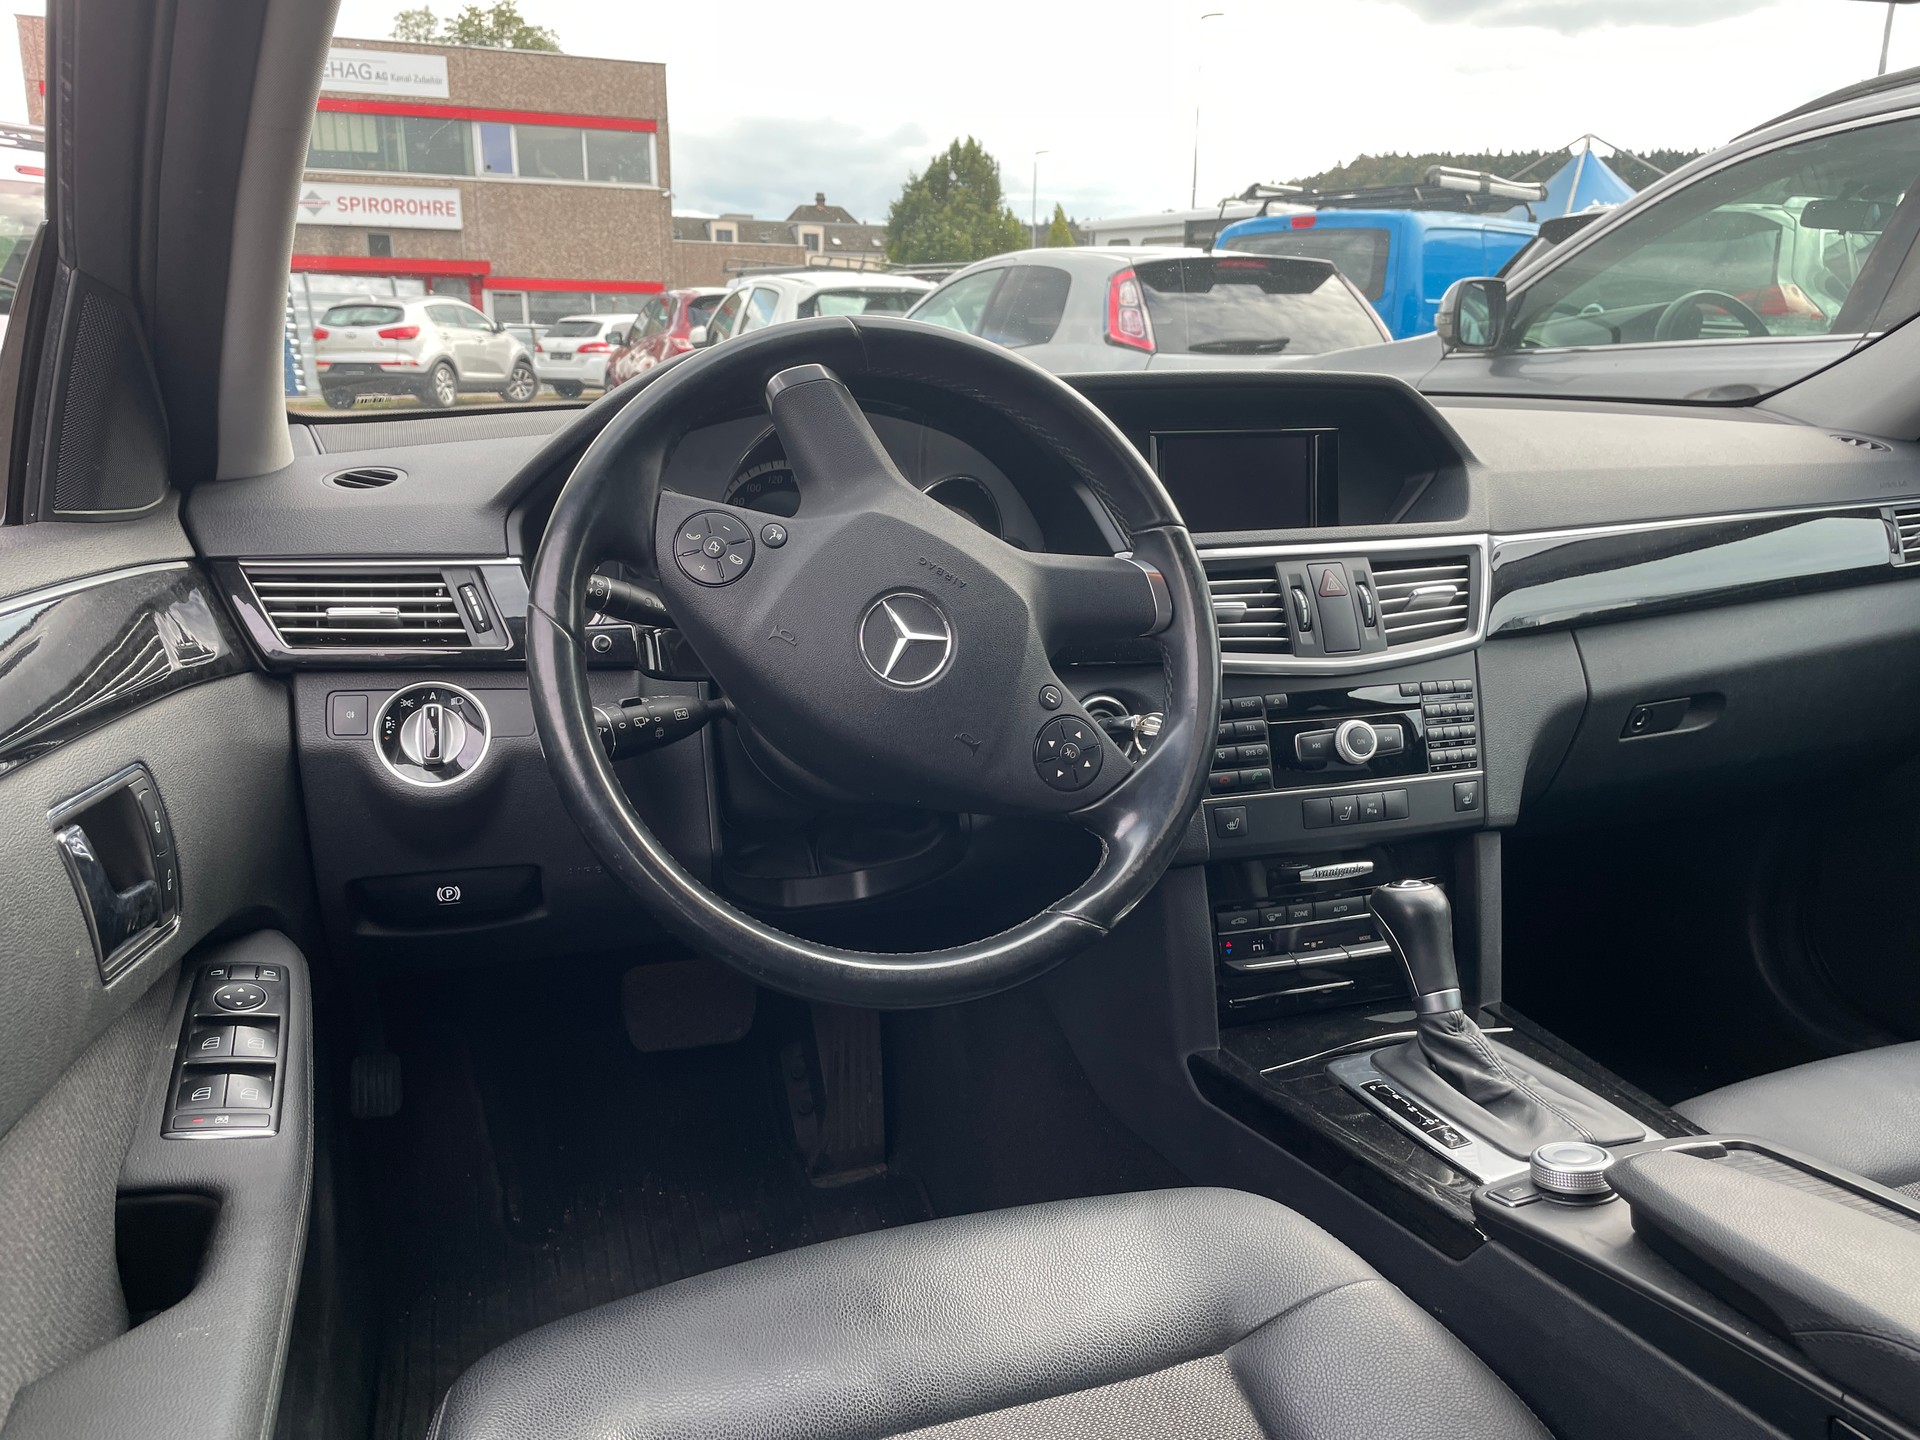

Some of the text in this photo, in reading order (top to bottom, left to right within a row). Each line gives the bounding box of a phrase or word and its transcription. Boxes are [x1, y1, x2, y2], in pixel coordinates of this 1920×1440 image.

[375, 71, 388, 81] AG
[337, 196, 456, 217] SPIROROHRE
[746, 483, 761, 493] 100
[733, 497, 744, 505] 80
[919, 556, 967, 588] AIRBAG
[429, 692, 437, 700] A
[385, 721, 392, 729] P
[1064, 747, 1076, 758] OK
[1294, 910, 1308, 918] ZONE
